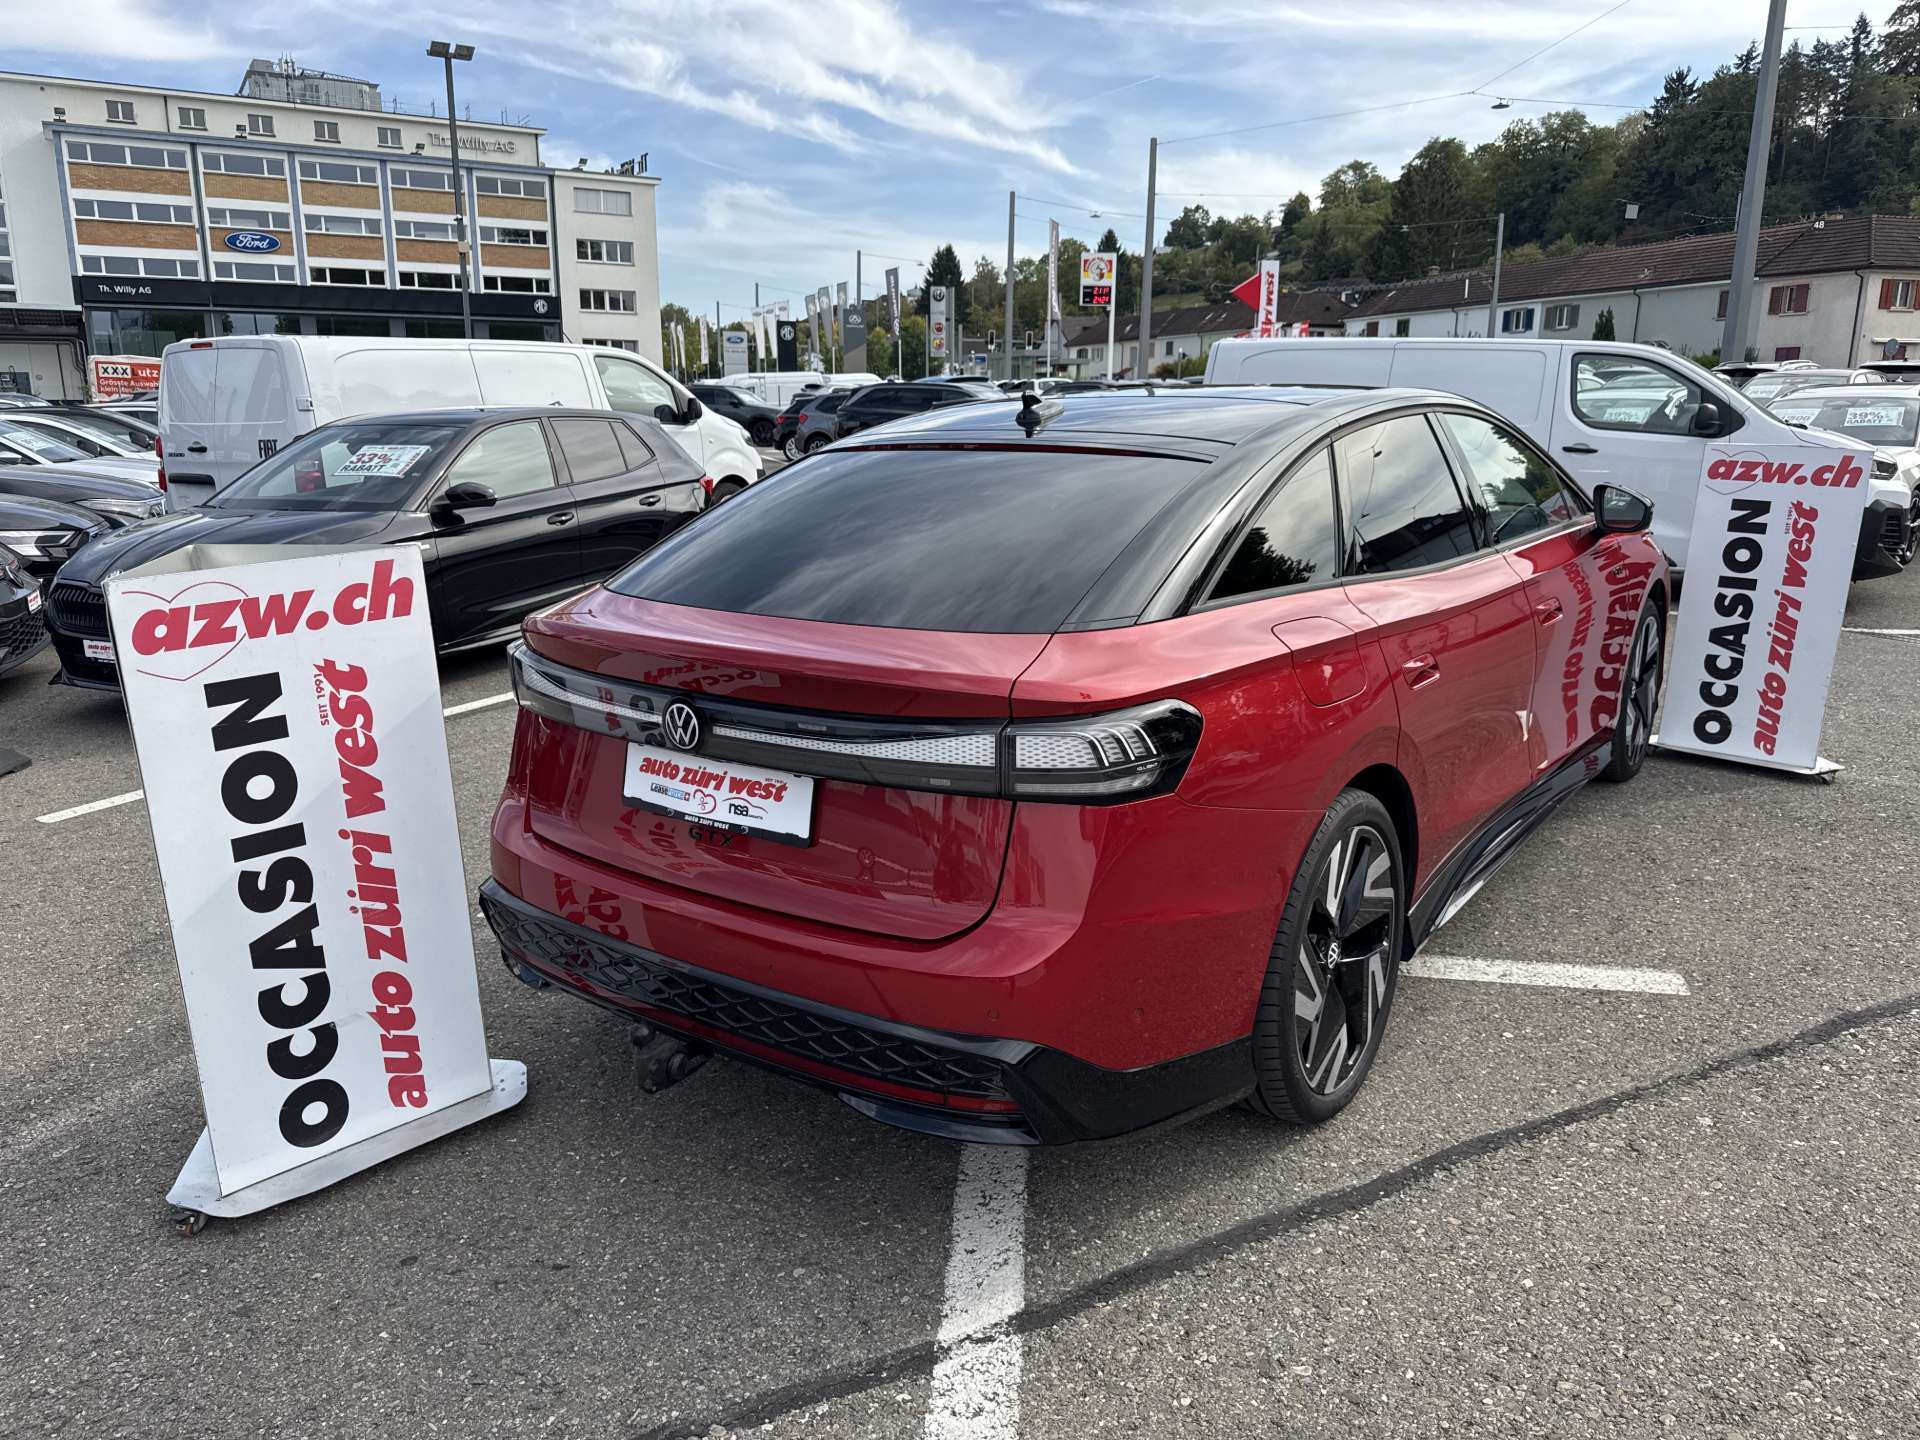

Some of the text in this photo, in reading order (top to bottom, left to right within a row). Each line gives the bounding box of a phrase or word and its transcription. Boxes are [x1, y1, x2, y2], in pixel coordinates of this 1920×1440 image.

[457, 136, 490, 153] Willy
[494, 139, 516, 154] AG
[1813, 220, 1825, 229] 48
[235, 233, 271, 249] Ford
[97, 284, 152, 296] Th. Willy AG
[130, 380, 159, 388] Auswah
[258, 439, 278, 459] FIAT
[349, 453, 393, 465] 33%
[340, 464, 387, 472] RABATT
[1707, 455, 1863, 488] azw.ch
[132, 559, 415, 656] azw.ch
[1693, 498, 1772, 744] OCCASION
[1754, 500, 1819, 756] auto züri west
[314, 674, 329, 726] SEIT 1991
[639, 756, 789, 803] auto züri west
[728, 802, 749, 817] nsa
[689, 827, 733, 848] GTX
[313, 659, 429, 1108] auto züri west
[204, 672, 350, 1148] OCCASION
